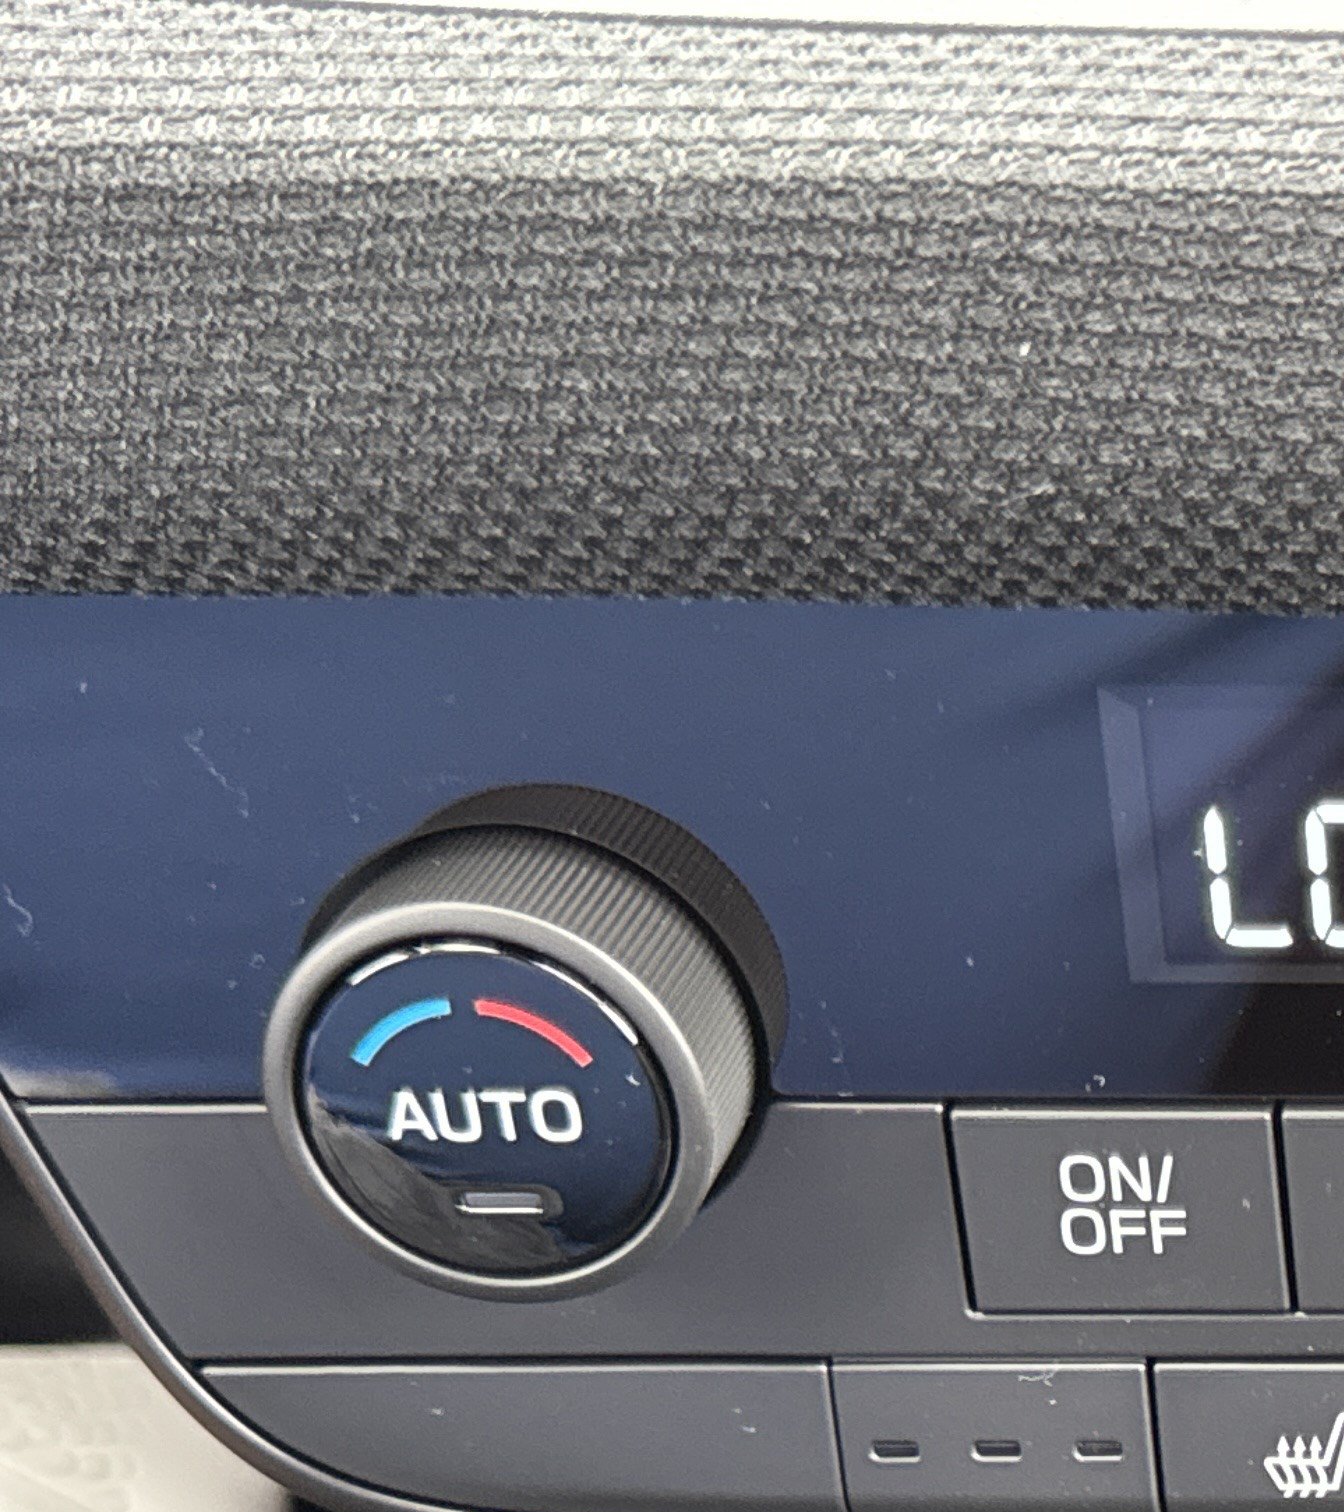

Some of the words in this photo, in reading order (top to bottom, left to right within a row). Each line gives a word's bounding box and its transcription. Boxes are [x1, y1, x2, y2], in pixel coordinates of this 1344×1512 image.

[387, 1088, 583, 1143] AUTO
[1058, 1153, 1173, 1203] ON/
[1060, 1207, 1186, 1255] OFF
